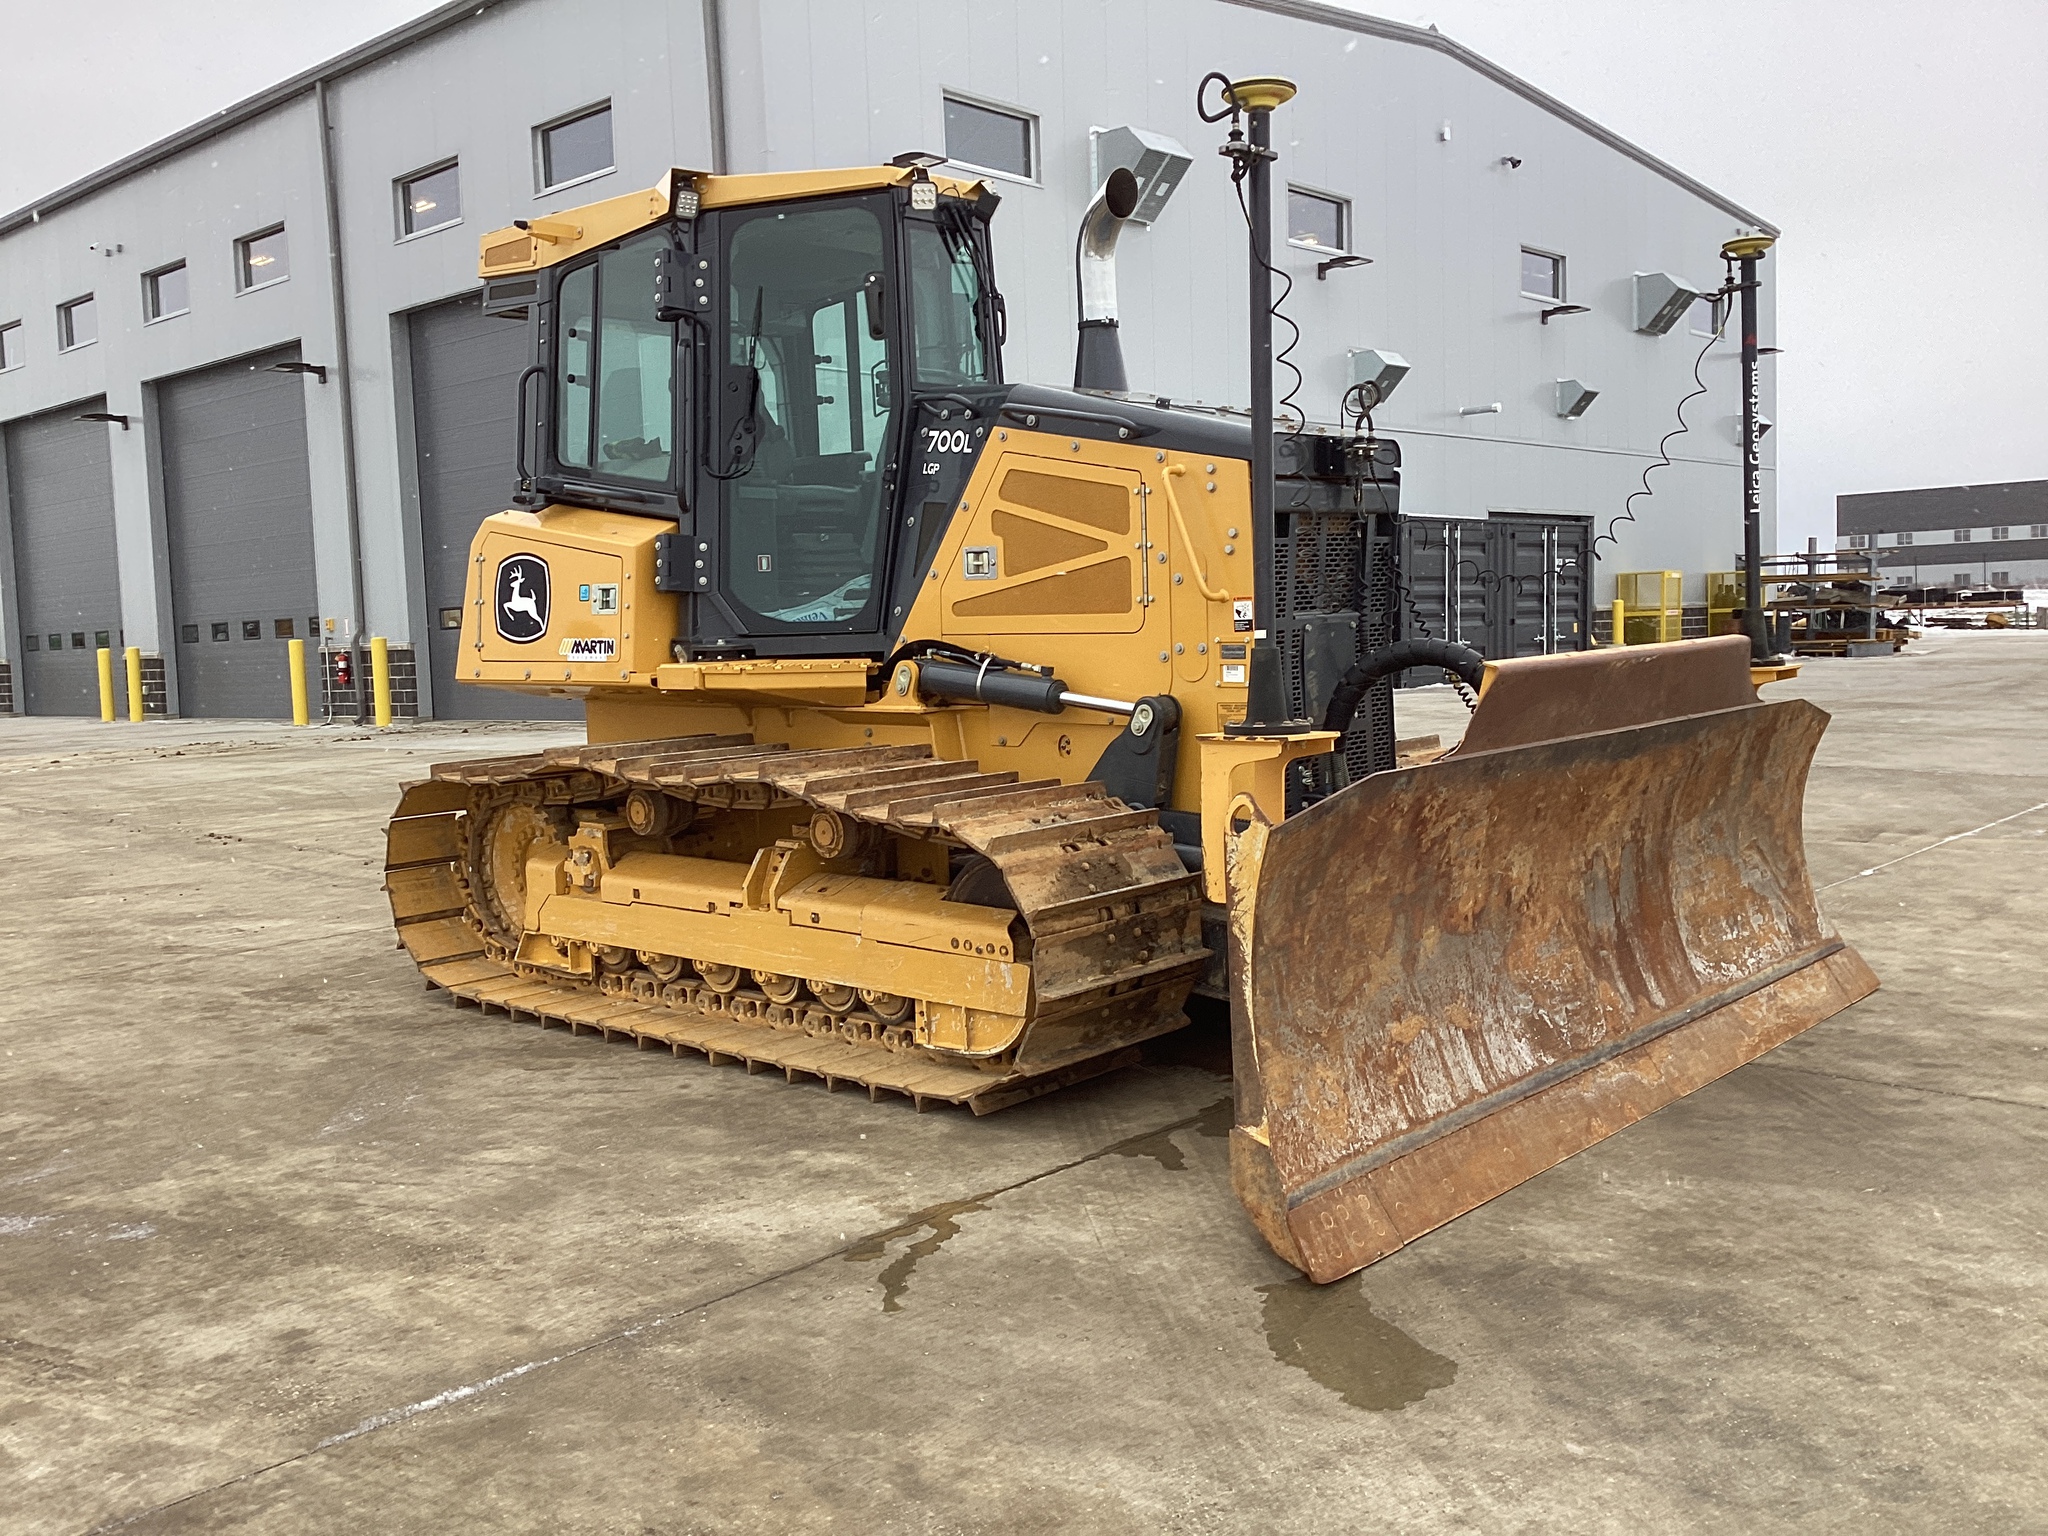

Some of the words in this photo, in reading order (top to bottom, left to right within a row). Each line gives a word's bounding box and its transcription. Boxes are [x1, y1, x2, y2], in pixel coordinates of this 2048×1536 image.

[1749, 361, 1760, 465] Geosystems
[927, 429, 973, 453] 700L
[922, 462, 940, 475] LGP
[1748, 470, 1760, 513] Leica
[571, 639, 614, 654] MARTIN
